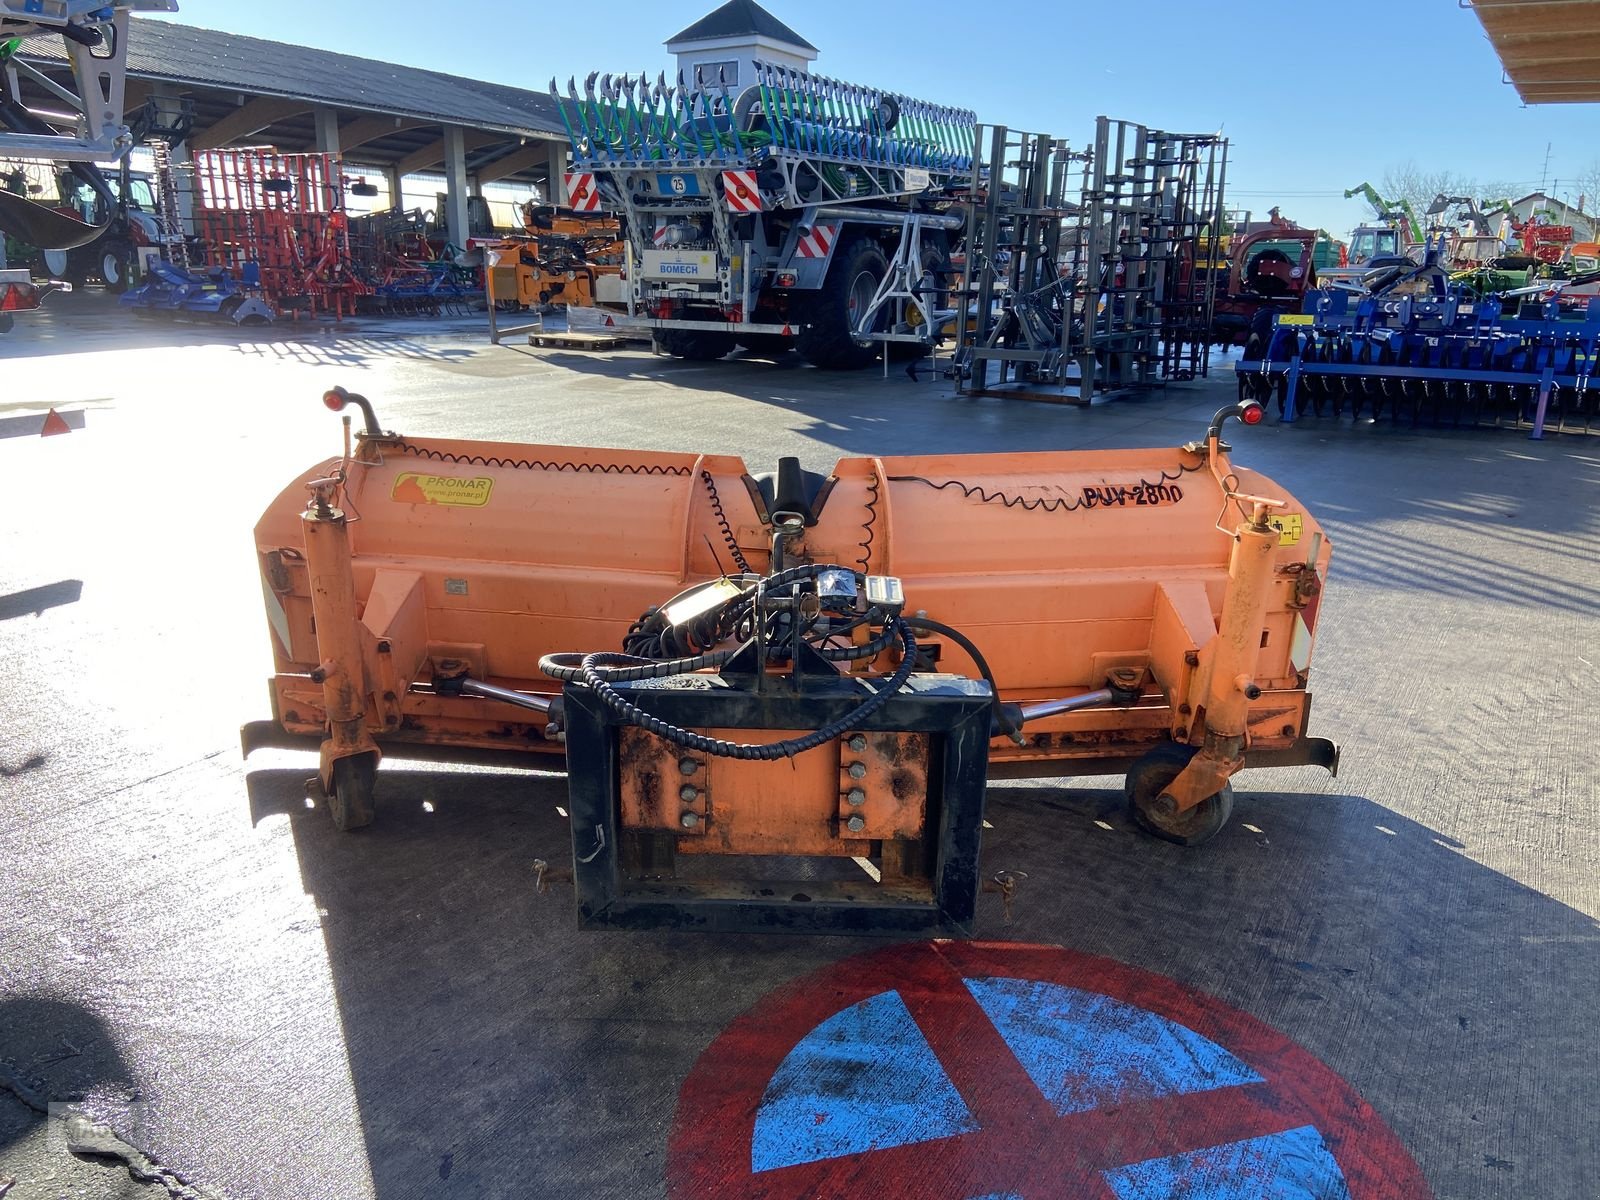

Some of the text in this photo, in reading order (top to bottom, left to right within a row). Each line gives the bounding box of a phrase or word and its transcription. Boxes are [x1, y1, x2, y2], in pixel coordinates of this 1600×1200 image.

[674, 179, 683, 190] 25
[660, 265, 698, 274] BOMECH
[426, 478, 486, 489] PRONAR
[427, 489, 483, 499] www.pronar.pl
